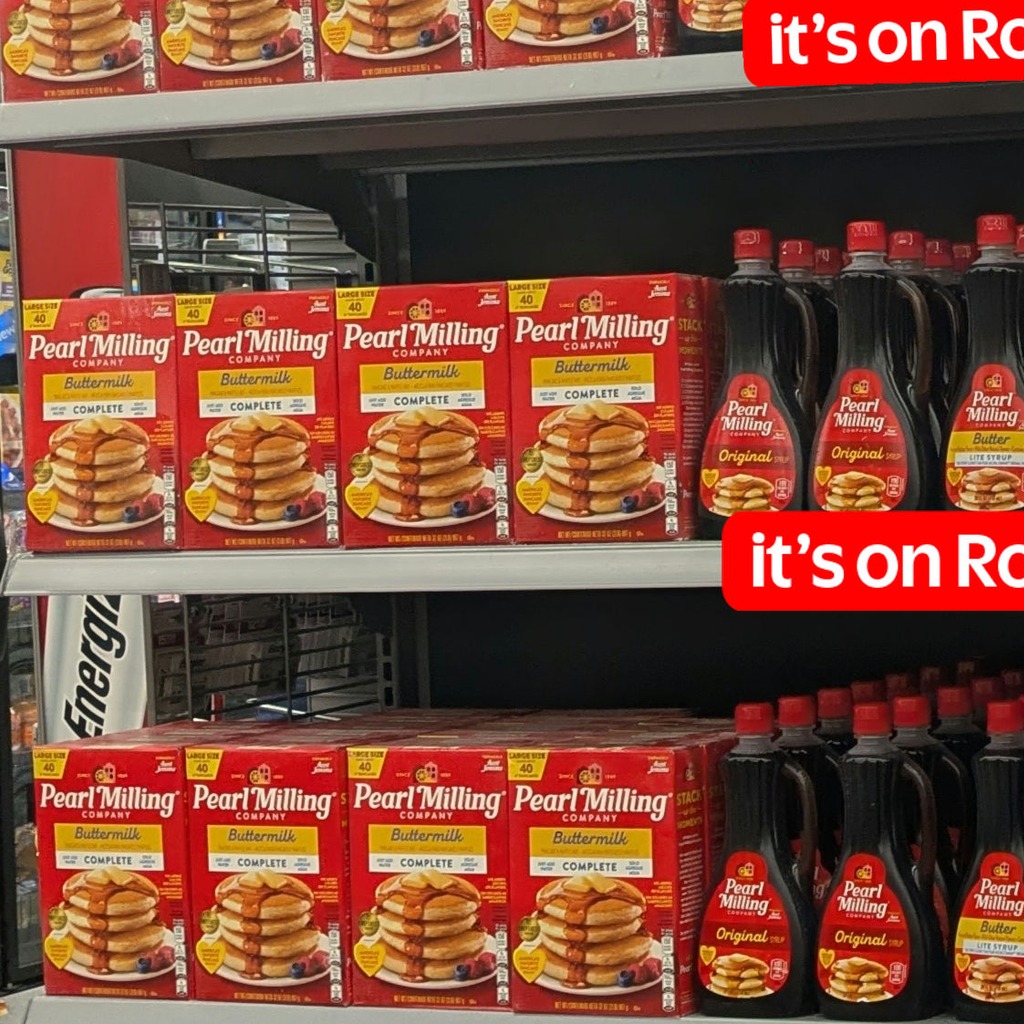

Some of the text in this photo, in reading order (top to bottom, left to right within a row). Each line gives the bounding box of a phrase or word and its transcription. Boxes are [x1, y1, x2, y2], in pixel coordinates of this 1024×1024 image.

[343, 322, 499, 353] Pearl Milling
[515, 314, 669, 346] Pearl Milling
[28, 333, 170, 364] Pearl Milling
[183, 329, 329, 359] Pearl Milling
[563, 341, 619, 351] COMPANY
[229, 354, 281, 364] COMPANY
[392, 348, 448, 358] COMPANY
[73, 359, 124, 368] COMPANY
[554, 357, 631, 374] Buttermilk
[220, 371, 293, 386] Buttermilk
[384, 365, 461, 380] Buttermilk
[64, 374, 134, 389] Buttermilk
[394, 396, 449, 406] COMPLETE
[565, 389, 619, 400] COMPLETE
[972, 391, 1013, 407] Pearl
[73, 405, 123, 414] COMPLETE
[230, 401, 282, 411] COMPLETE
[728, 401, 768, 416] Pearl
[840, 397, 879, 412] Pearl
[834, 412, 885, 432] Milling
[966, 407, 1018, 426] Milling
[721, 416, 773, 436] Milling
[973, 433, 1010, 444] Butter
[719, 450, 772, 465] Original
[831, 447, 884, 462] Original
[64, 595, 126, 739] Energi
[39, 784, 174, 818] Pearl Milling
[192, 785, 331, 820] Pearl Milling
[353, 783, 501, 819] Pearl Milling
[514, 785, 668, 821] Pearl Milling
[82, 811, 130, 819] COMPANY
[236, 813, 286, 821] COMPANY
[400, 812, 453, 820] COMPANY
[562, 814, 617, 822] COMPANY
[75, 827, 142, 840] Buttermilk
[228, 829, 297, 842] Buttermilk
[391, 829, 464, 842] Buttermilk
[553, 832, 629, 845] Buttermilk
[84, 856, 132, 865] COMPLETE
[238, 859, 287, 868] COMPLETE
[401, 859, 453, 868] COMPLETE
[563, 862, 617, 871] COMPLETE
[725, 878, 764, 895] Pearl
[843, 881, 883, 898] Pearl
[980, 879, 1019, 896] Pearl
[719, 894, 769, 913] Milling
[838, 896, 888, 917] Milling
[974, 894, 1024, 916] Milling
[980, 922, 1016, 934] Butter
[716, 928, 768, 945] Original
[835, 931, 887, 947] Original
